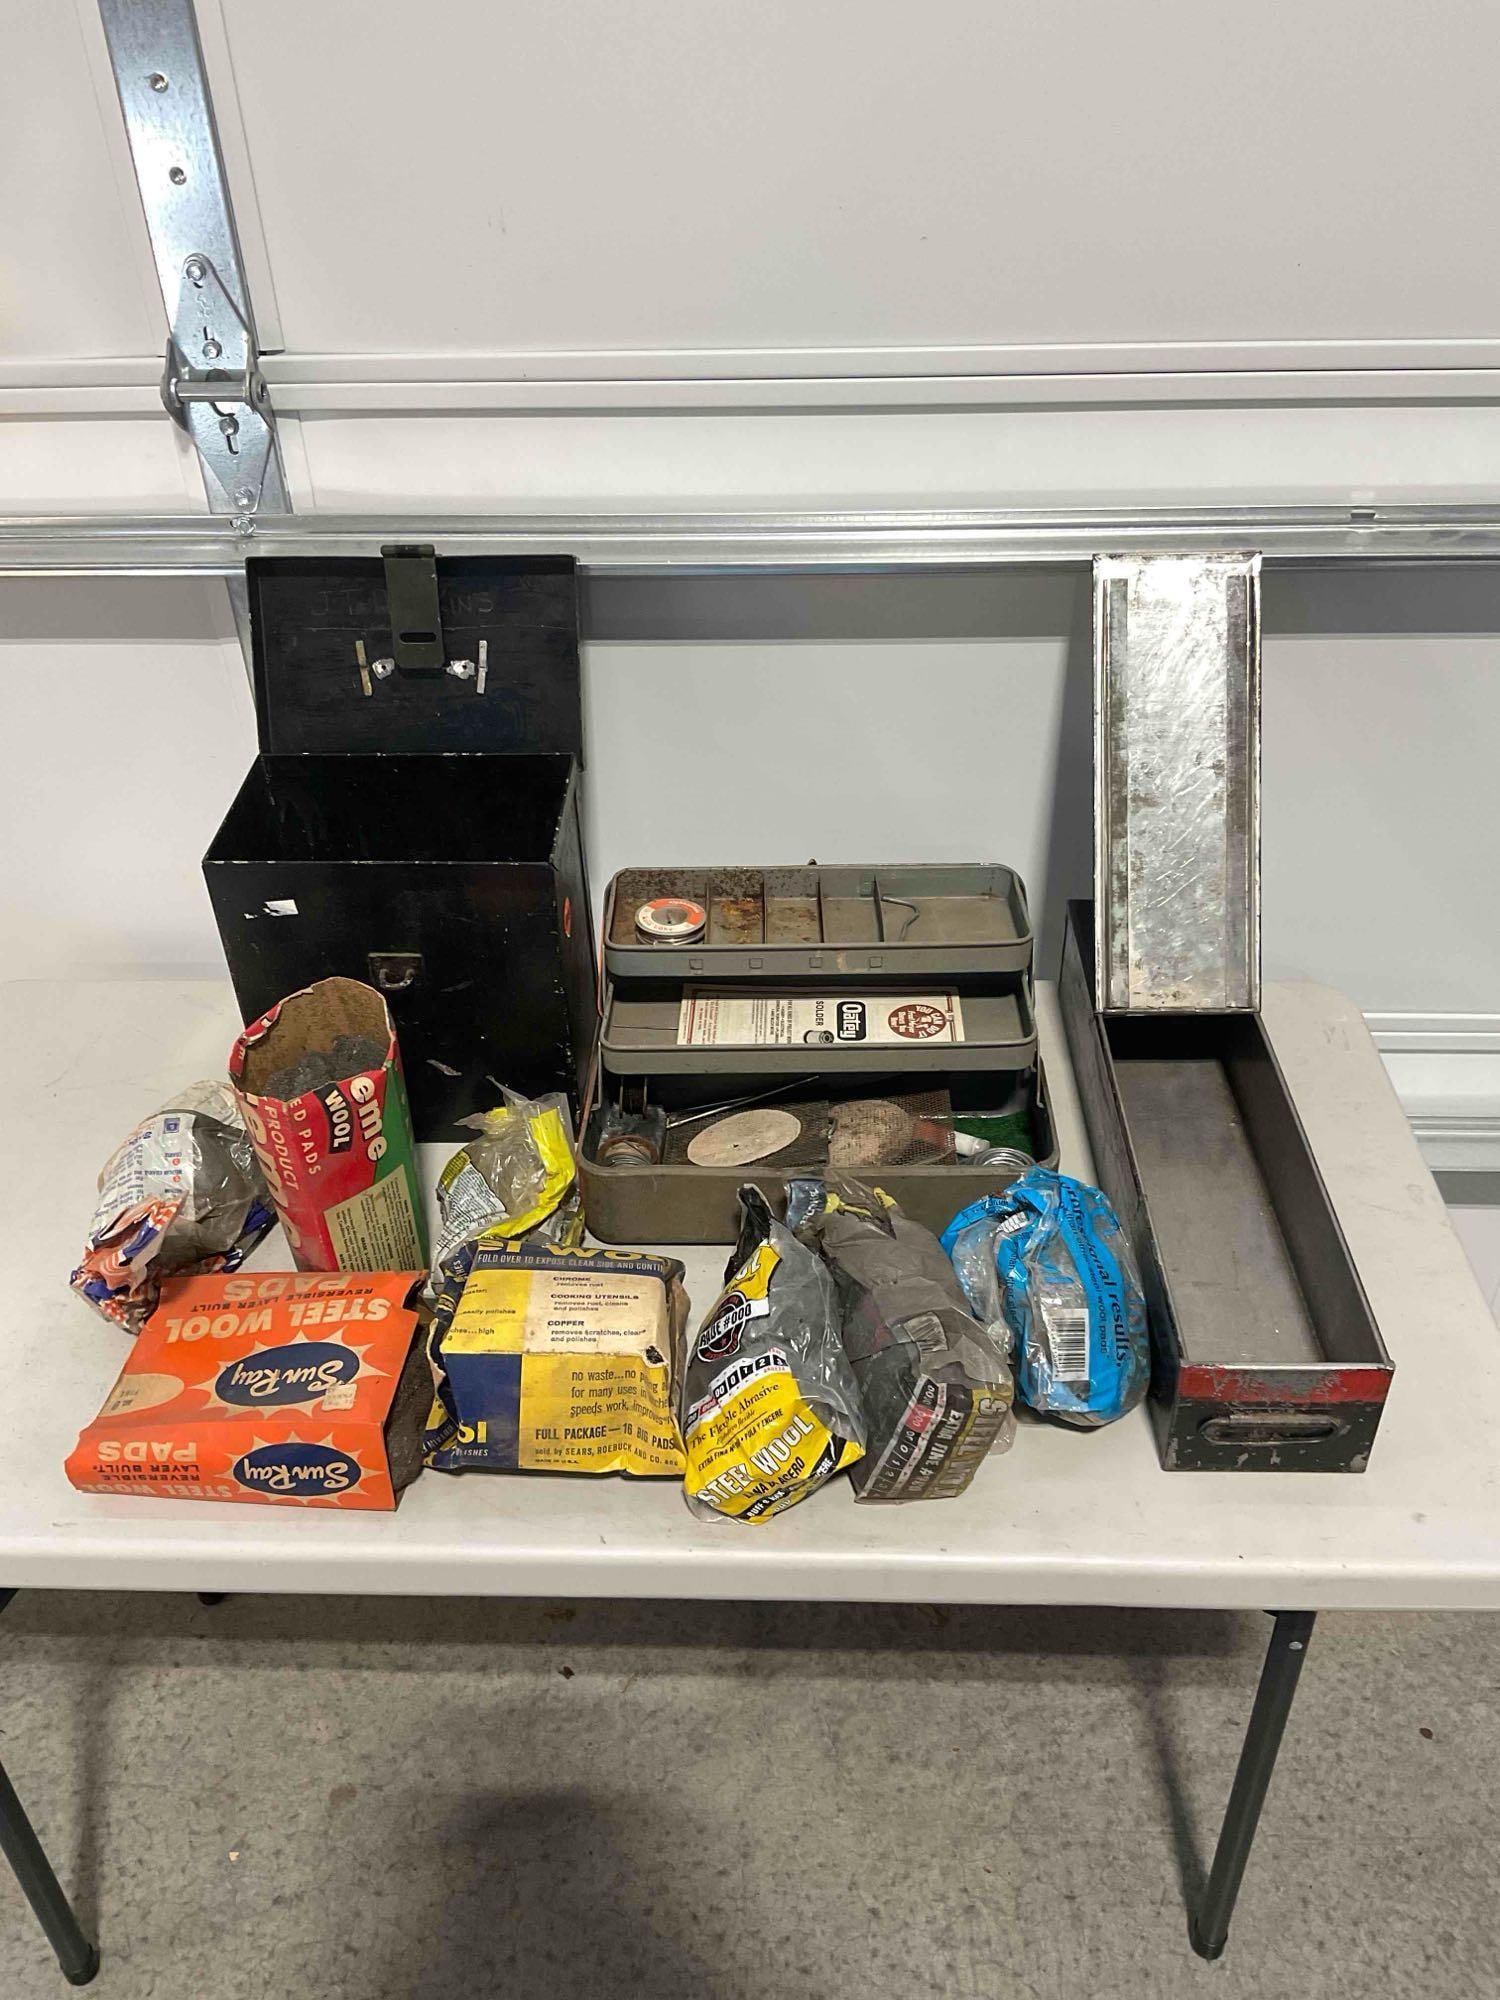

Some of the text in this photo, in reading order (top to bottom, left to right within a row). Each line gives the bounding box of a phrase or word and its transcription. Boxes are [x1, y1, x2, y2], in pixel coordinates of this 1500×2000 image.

[815, 1000, 824, 1026] SOLDER
[841, 1002, 864, 1038] Oatey
[325, 1090, 351, 1148] WOOL
[350, 1076, 388, 1162] eme
[264, 1105, 299, 1191] PRODUCT
[299, 1129, 321, 1175] PADS
[477, 1253, 498, 1264] FOLD
[500, 1254, 522, 1264] OVER
[524, 1256, 534, 1264] TO
[536, 1257, 566, 1266] EXPOSE
[568, 1258, 594, 1267] CLEAN
[596, 1260, 614, 1268] SIDE
[617, 1262, 634, 1270] AND
[190, 1287, 374, 1313] REVERSIBLE LAYER BUILT
[223, 1277, 350, 1301] PADS
[723, 1303, 752, 1328] #000
[1099, 1294, 1108, 1320] wool
[165, 1298, 391, 1343] STEEL WOOL
[1109, 1291, 1131, 1368] results.
[571, 1371, 583, 1381] no
[715, 1386, 725, 1397] 00
[759, 1358, 766, 1367] 2
[571, 1384, 647, 1398] for many uses in
[570, 1402, 602, 1418] speeds
[606, 1399, 629, 1412] work,
[692, 1433, 706, 1448] The
[739, 1384, 779, 1412] Abrasive
[912, 1410, 924, 1427] 000
[535, 1423, 675, 1450] FULL PACKAGE 16 BIG PADS
[937, 1409, 965, 1440] EXTRA
[98, 1440, 197, 1463] PADS
[554, 1447, 562, 1456] by
[565, 1447, 595, 1457] SEARS,
[597, 1443, 632, 1455] ROEBUCK
[634, 1448, 647, 1459] AND
[650, 1454, 662, 1464] CO.
[750, 1414, 814, 1476] WOOL
[900, 1444, 909, 1453] 0
[925, 1442, 950, 1466] FINE
[153, 1464, 200, 1474] LAYER
[243, 1458, 350, 1491] Sun Ray
[698, 1456, 714, 1472] EXTRA
[101, 1473, 200, 1482] REVERSIBLE
[159, 1483, 233, 1498] STEEL
[744, 1482, 769, 1499] LNA
[779, 1456, 805, 1485] ACERO
[746, 1502, 762, 1517] BUFF
